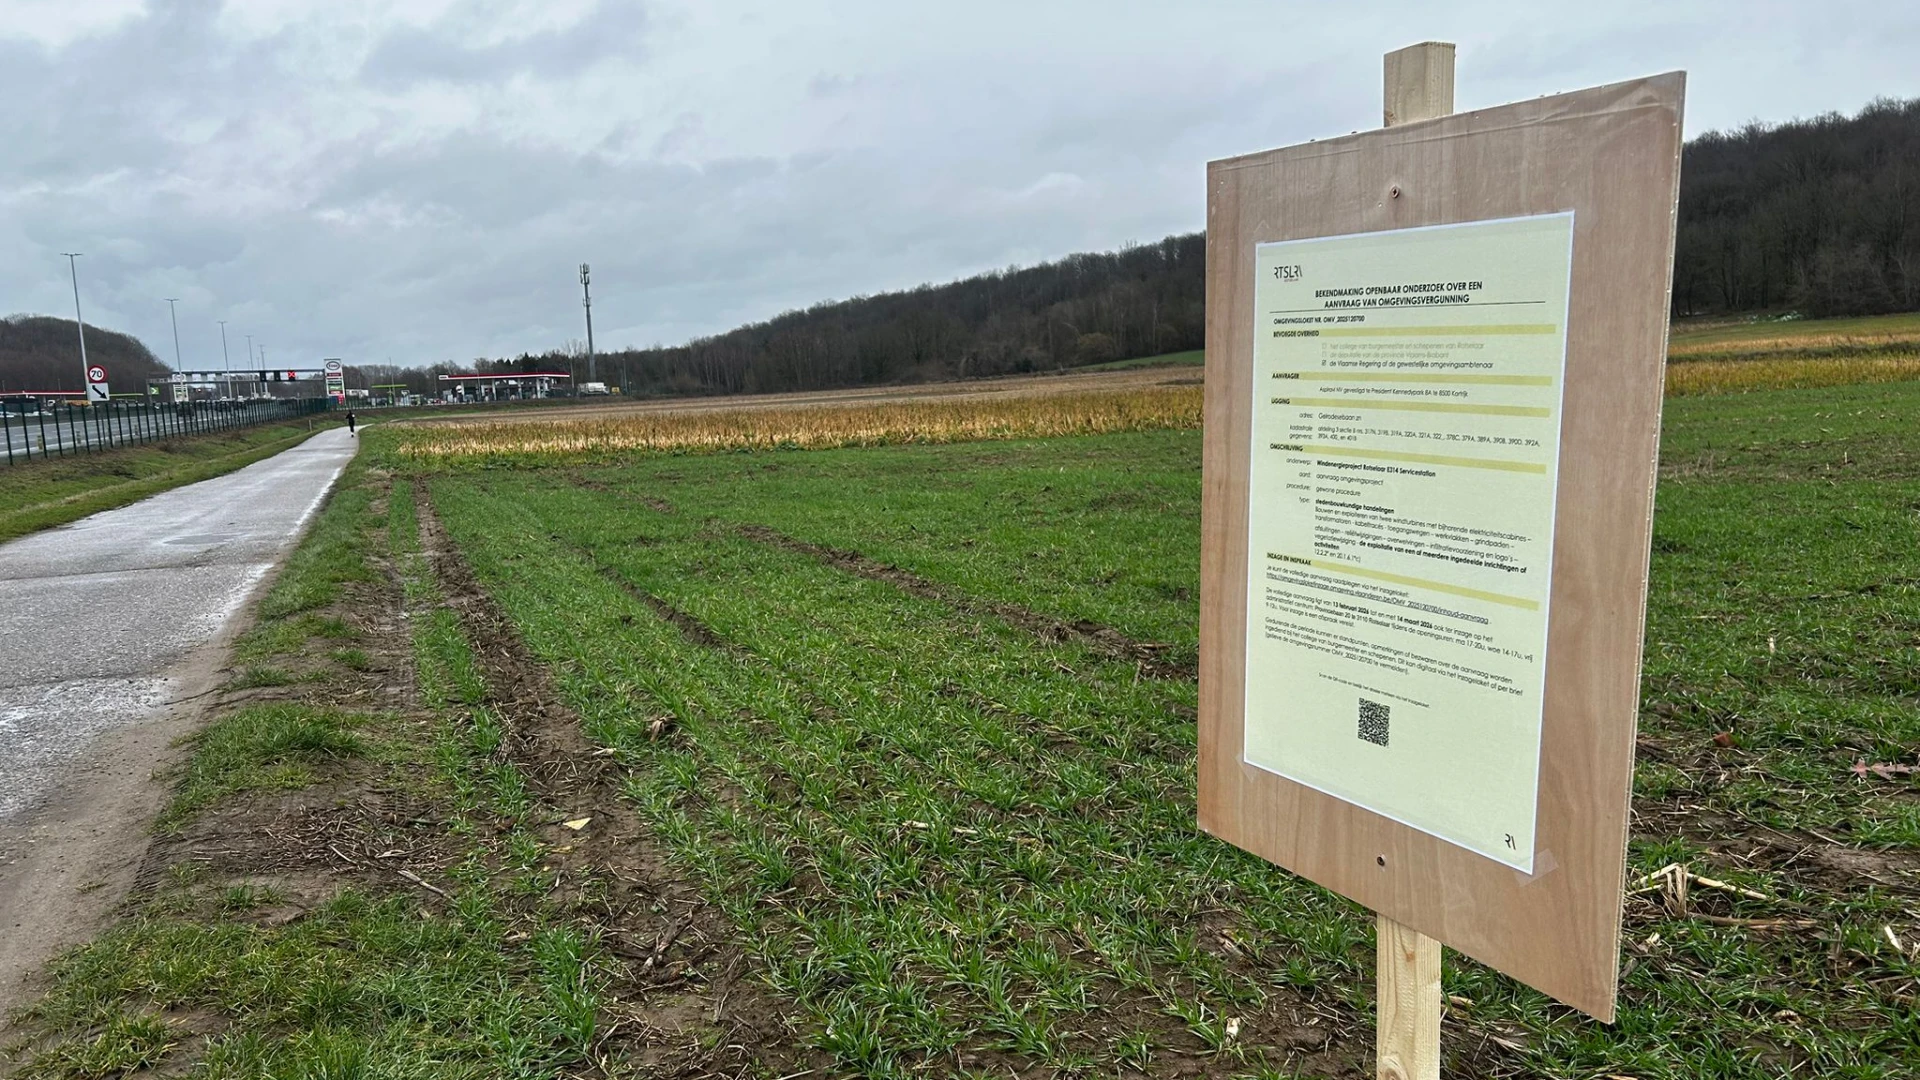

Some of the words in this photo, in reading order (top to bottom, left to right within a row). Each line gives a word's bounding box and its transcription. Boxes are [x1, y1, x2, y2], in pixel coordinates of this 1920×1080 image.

[1315, 287, 1363, 297] BEKENDMAKING
[1365, 285, 1400, 294] OPENBAAR
[1402, 283, 1444, 293] ONDERZOEK
[1446, 282, 1466, 291] OVER
[1468, 281, 1482, 290] EEN
[1324, 299, 1360, 307] AANVRAAG
[1378, 294, 1469, 306] OMGEVINGSVERGUNNING
[1269, 443, 1303, 451] OMSCHRIJVING
[1317, 460, 1362, 470] Windenergieproject
[1399, 467, 1435, 476] Servicestation
[1340, 476, 1383, 485] omgevingsproject
[1315, 498, 1362, 510] stedenbouwkundige
[1363, 504, 1394, 514] handelingen
[1387, 525, 1429, 536] toegangswegen
[1474, 538, 1509, 548] grindpaden
[1393, 518, 1425, 527] windturbines
[1438, 523, 1467, 533] bijhorende
[1469, 529, 1526, 542] elektriciteitscabines
[1290, 557, 1310, 565] INSPRAAK
[1367, 542, 1392, 550] exploitatie
[1422, 551, 1448, 560] meerdere
[1450, 555, 1482, 566] ingedeelde
[1484, 561, 1518, 572] inrichtingen
[1289, 570, 1308, 578] volledige
[1310, 574, 1332, 583] aanvraag
[1339, 602, 1356, 611] februari
[1454, 628, 1472, 638] inzage
[1411, 653, 1436, 664] bezwaren
[1460, 666, 1488, 678] aanvraag
[1490, 674, 1512, 683] worden
[1416, 663, 1436, 673] digitaal
